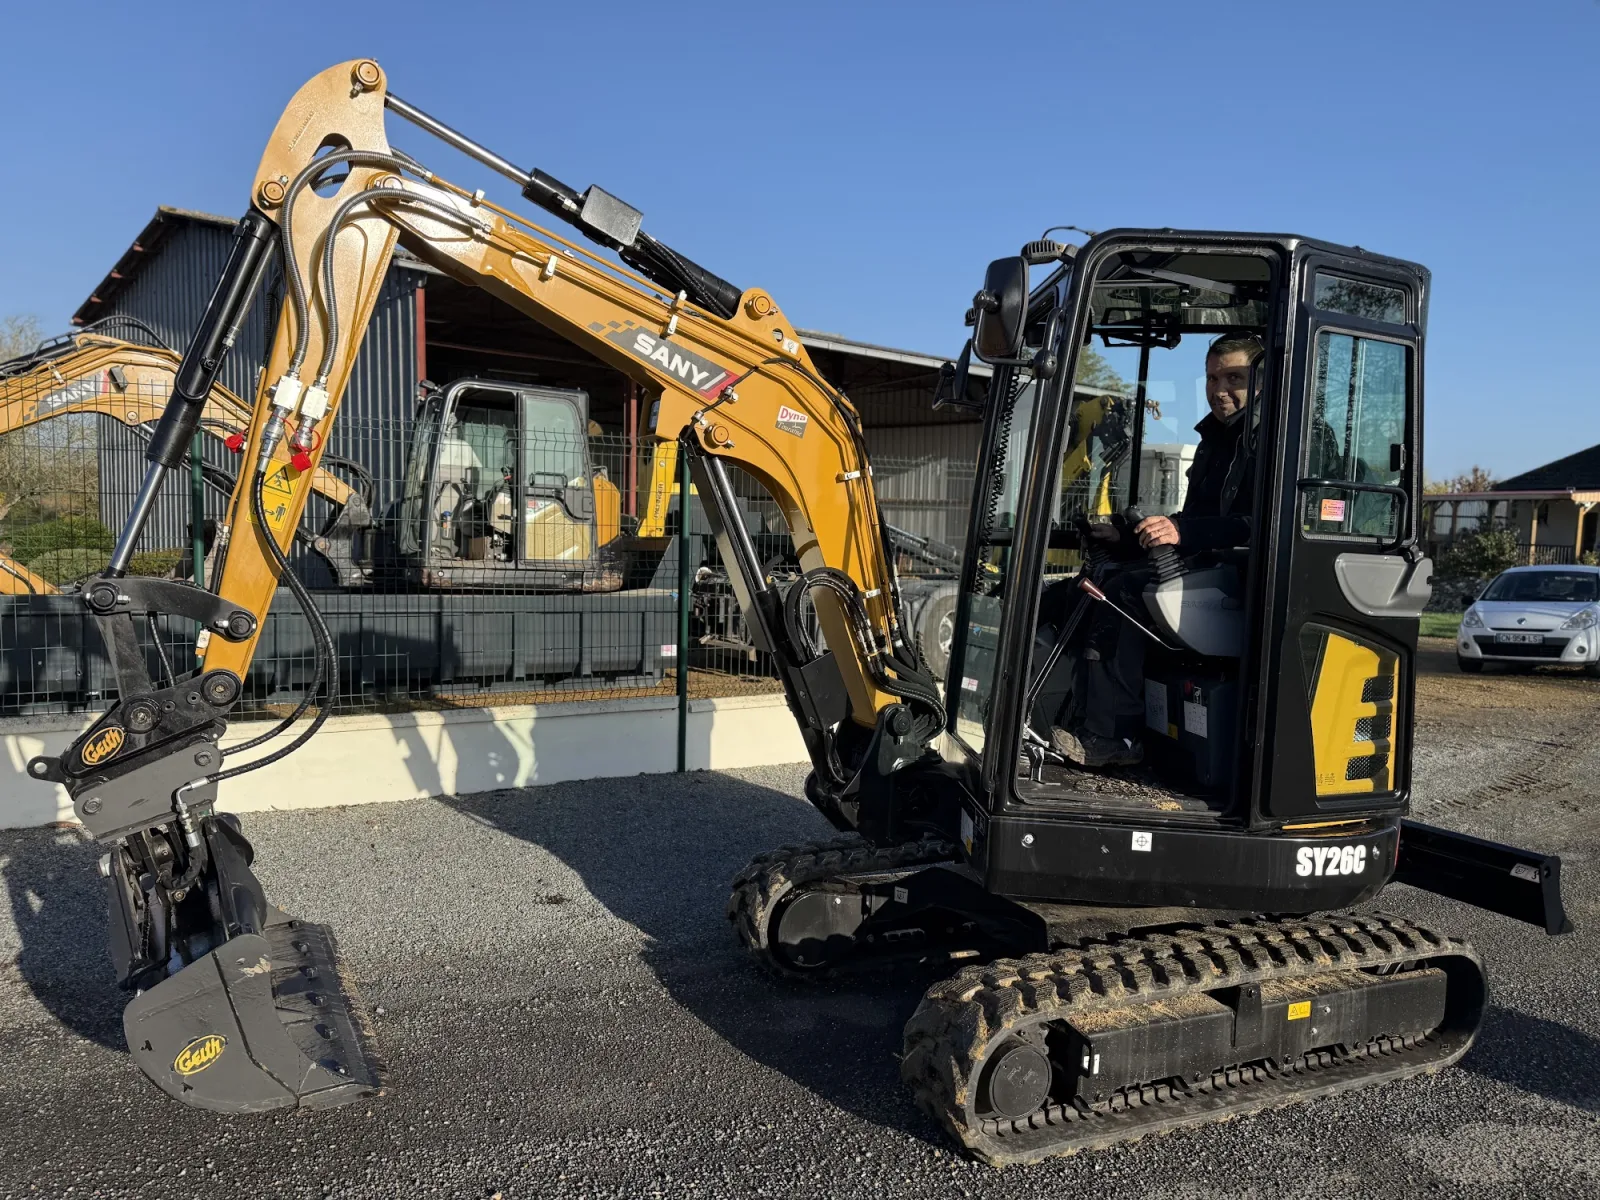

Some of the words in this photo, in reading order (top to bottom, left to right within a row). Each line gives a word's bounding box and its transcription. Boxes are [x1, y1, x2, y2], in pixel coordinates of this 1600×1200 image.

[633, 333, 710, 386] SANY
[46, 381, 96, 408] SANY
[780, 407, 806, 422] Dyna
[1295, 844, 1367, 877] SY26C
[178, 1037, 222, 1071] Geith
